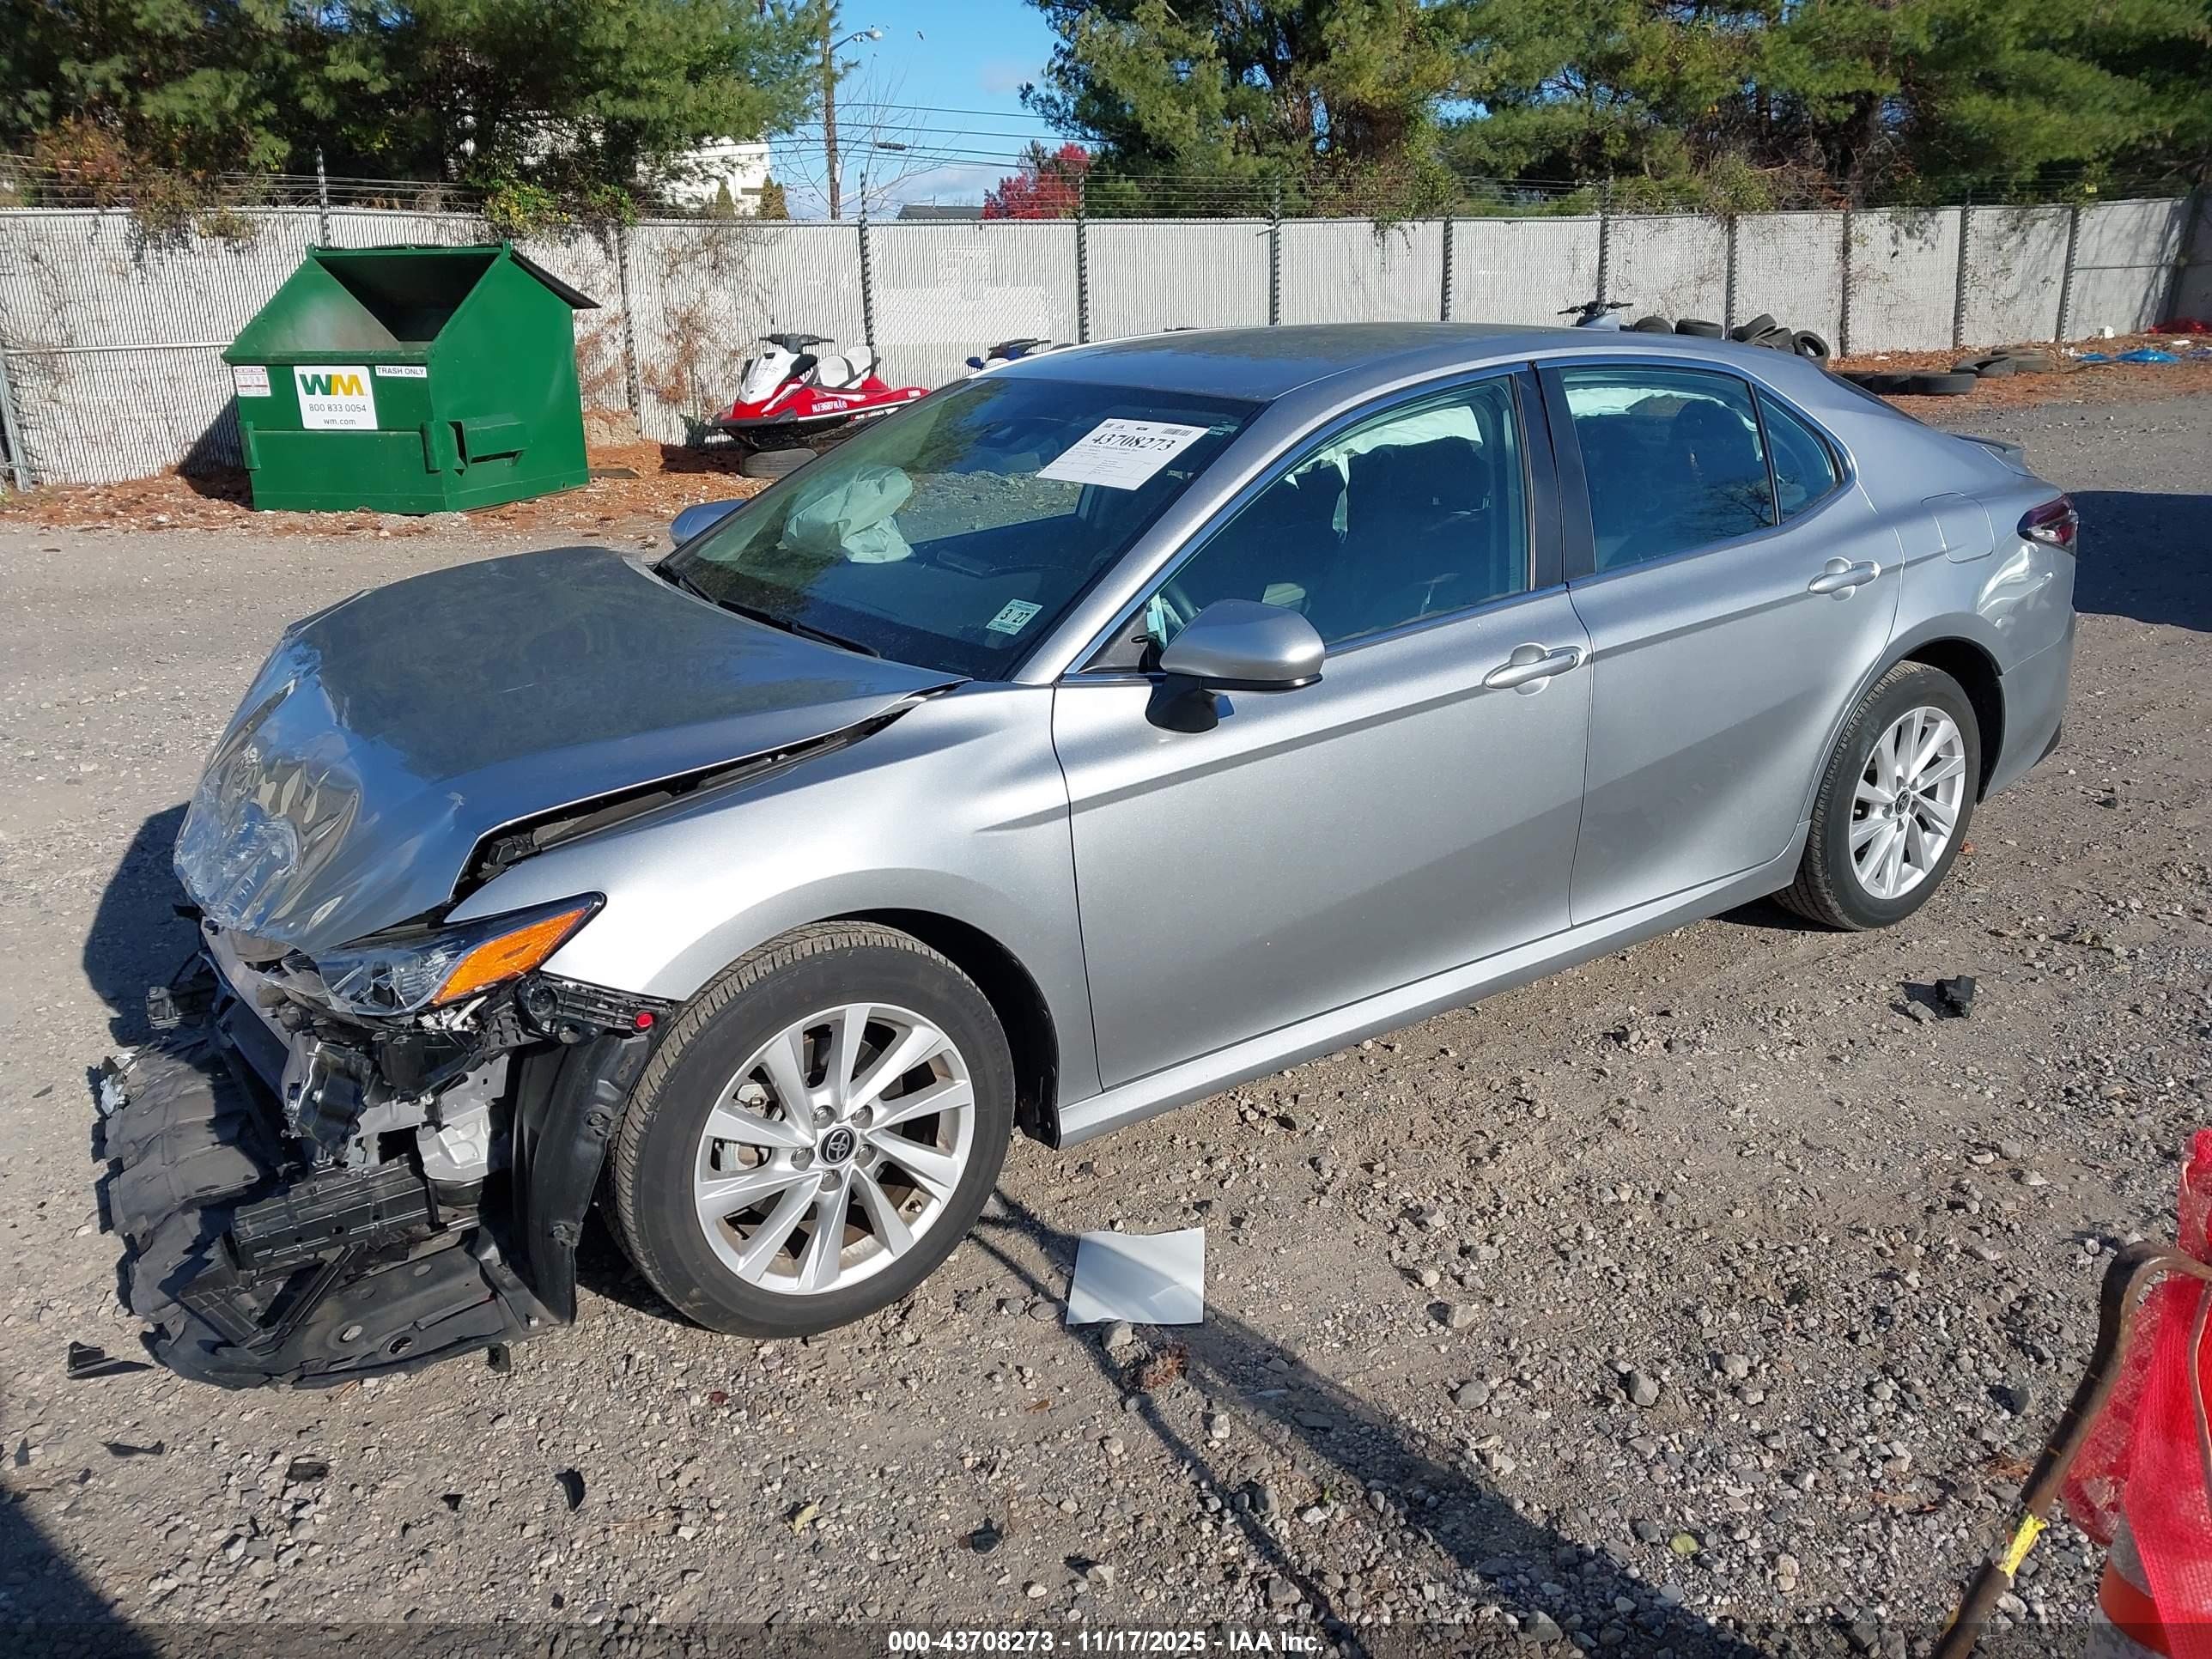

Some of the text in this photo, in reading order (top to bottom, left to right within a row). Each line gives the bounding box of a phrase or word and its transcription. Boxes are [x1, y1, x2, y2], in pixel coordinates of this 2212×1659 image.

[299, 374, 365, 396] WM
[308, 404, 367, 413] 800 833 0054
[323, 417, 356, 426] wm.com
[1091, 433, 1176, 451] 43708273
[1000, 609, 1031, 623] 3 27
